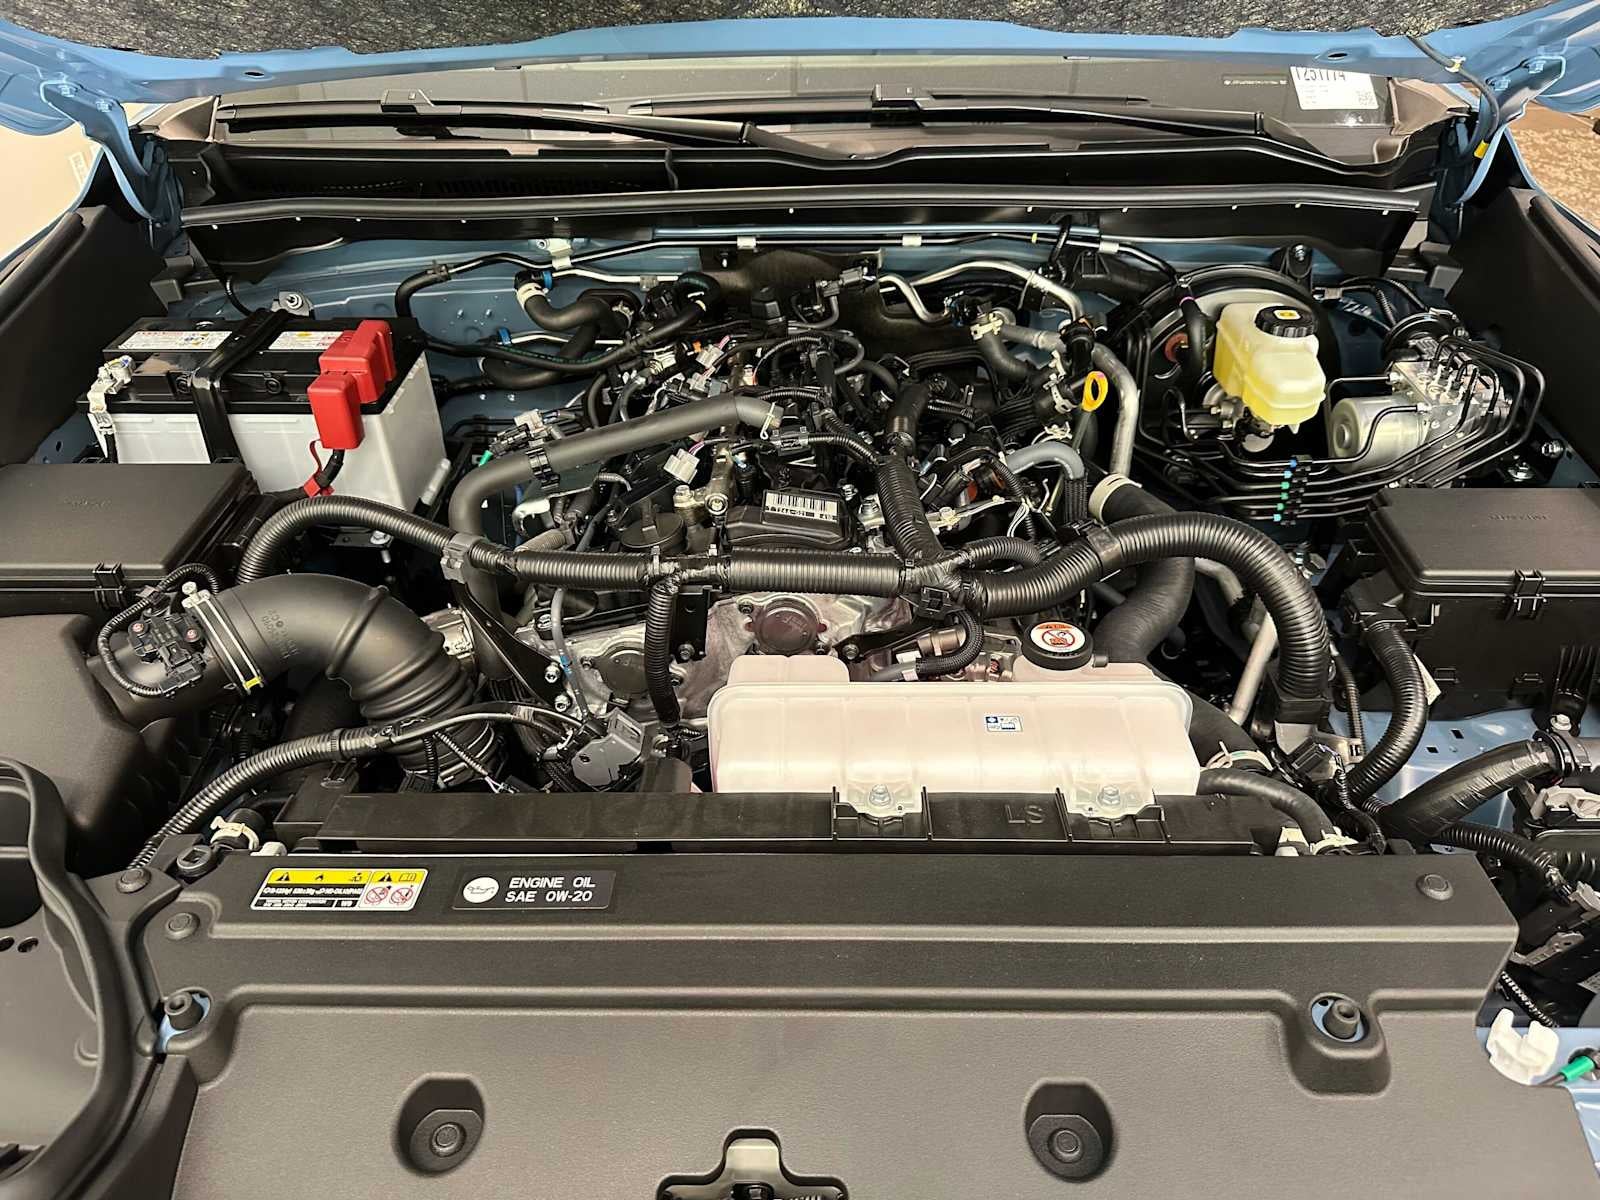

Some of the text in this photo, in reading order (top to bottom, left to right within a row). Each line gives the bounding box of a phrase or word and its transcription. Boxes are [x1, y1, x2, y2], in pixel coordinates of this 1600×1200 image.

[1005, 804, 1045, 824] LS
[509, 876, 596, 889] ENGINE OIL
[505, 890, 593, 903] SAE 0W-20
